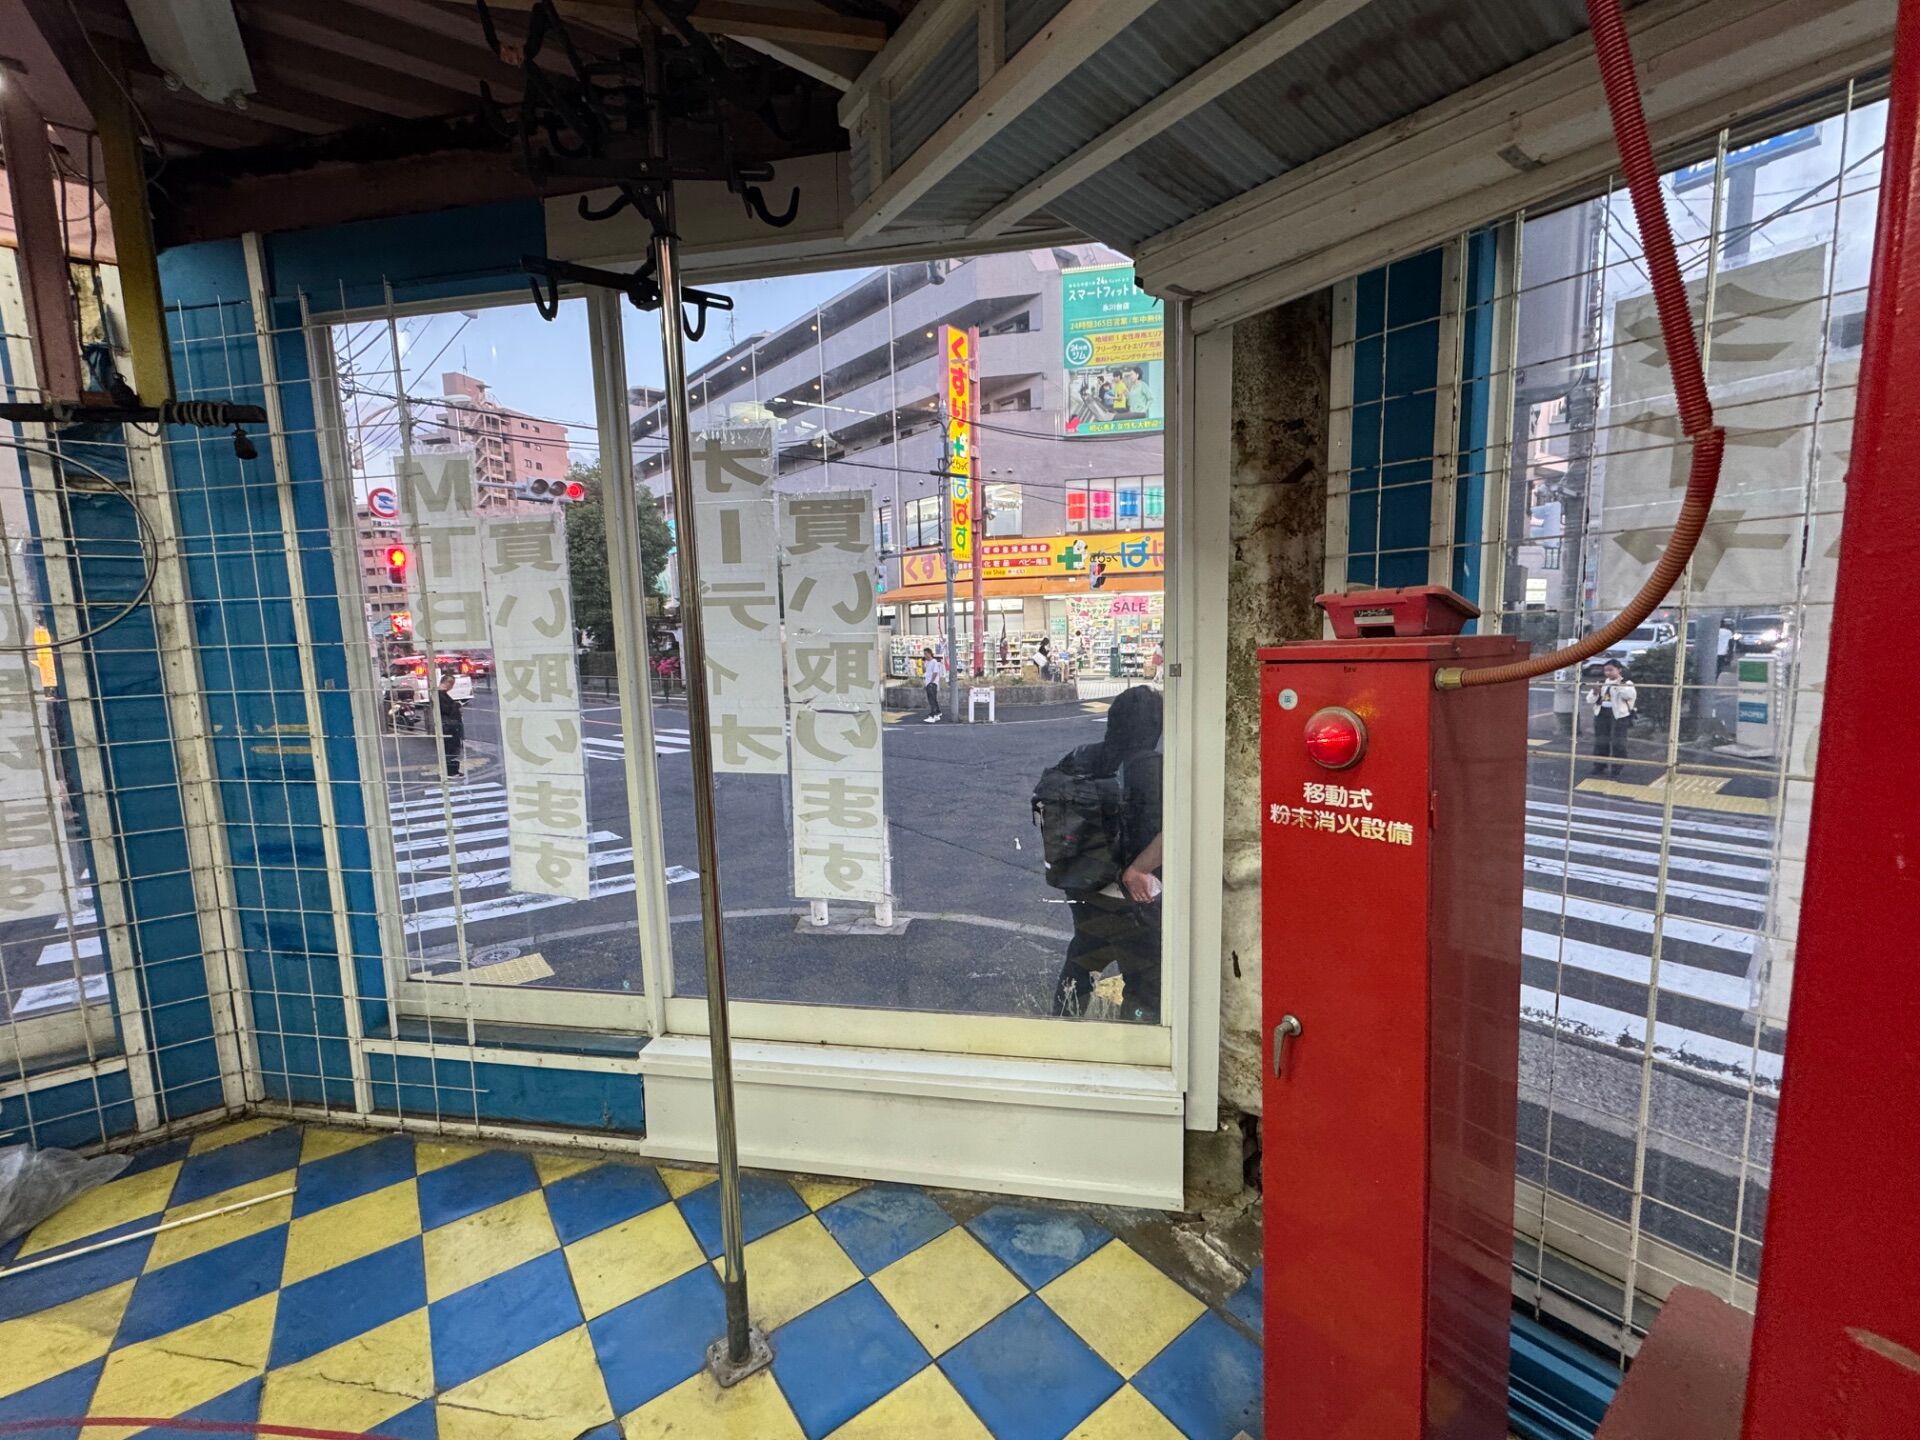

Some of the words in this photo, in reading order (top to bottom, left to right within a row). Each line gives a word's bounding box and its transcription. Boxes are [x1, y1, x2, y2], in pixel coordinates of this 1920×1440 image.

[951, 336, 967, 428] くすり
[952, 476, 969, 551] ぱぱす
[904, 555, 946, 581] くす
[1113, 601, 1147, 613] SALE
[1303, 781, 1373, 811] 移動式
[1269, 803, 1414, 846] 粉末消火設備
